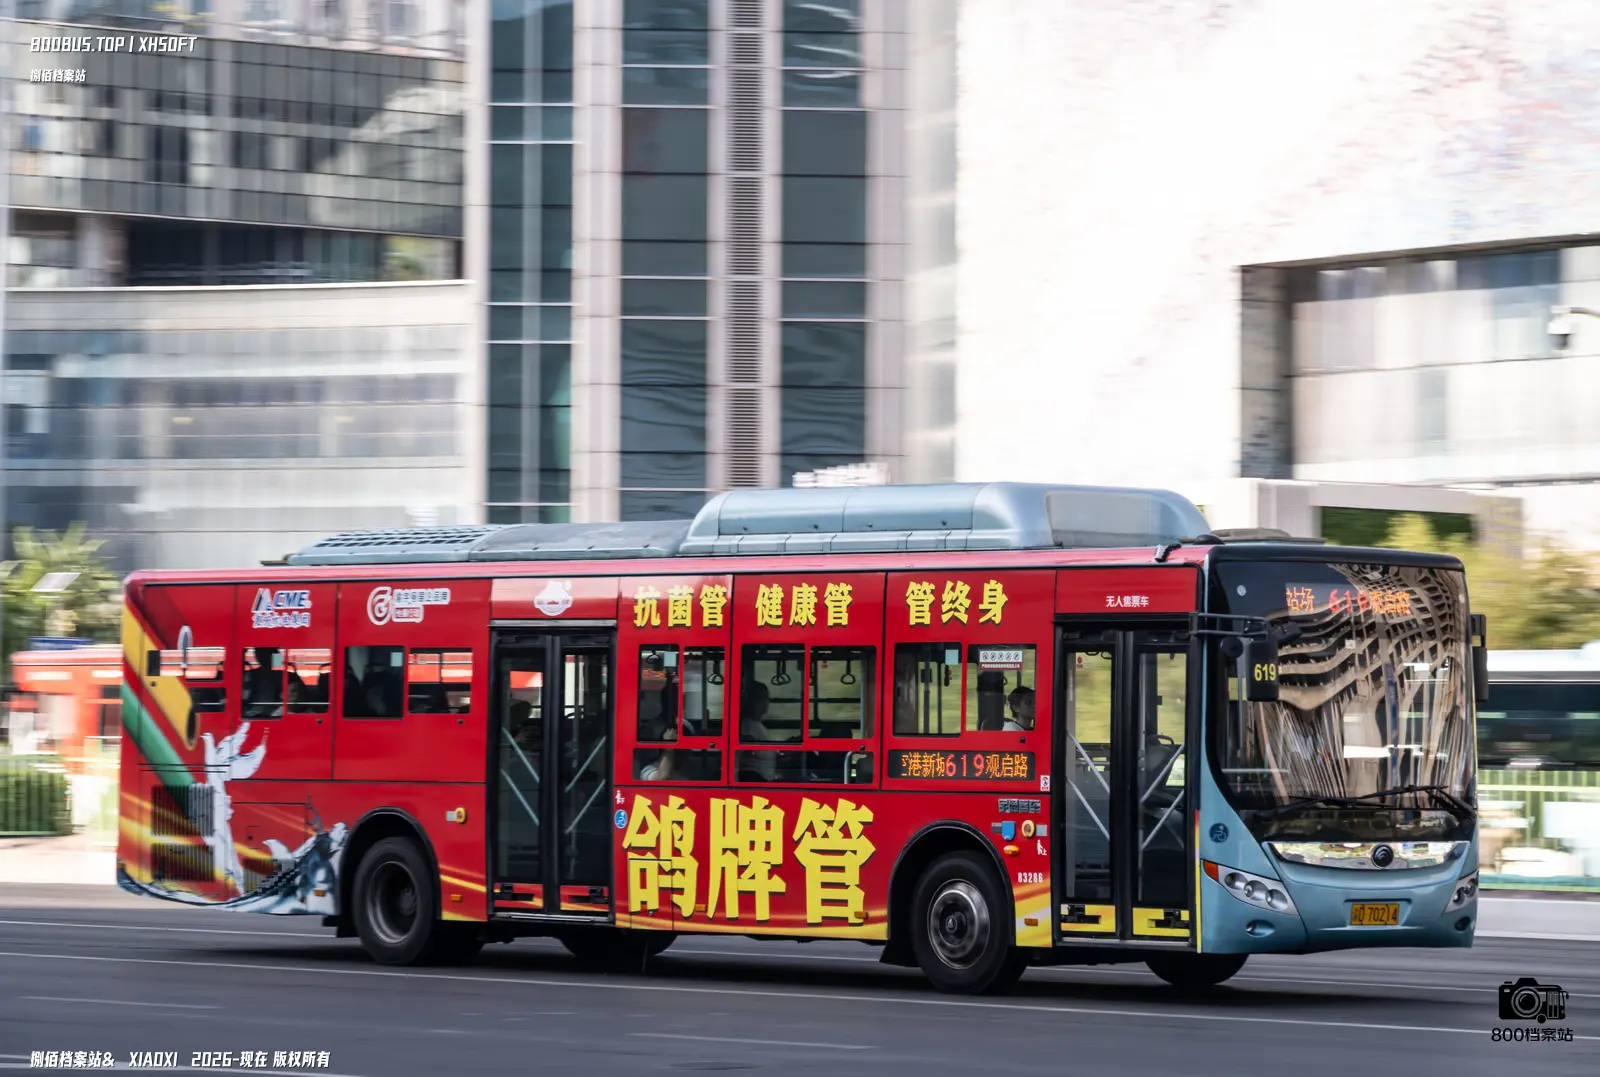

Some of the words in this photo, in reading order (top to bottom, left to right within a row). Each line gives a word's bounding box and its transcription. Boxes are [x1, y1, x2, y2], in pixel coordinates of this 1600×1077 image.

[633, 584, 728, 628] 抗菌管
[755, 582, 853, 627] 健康管
[905, 579, 1009, 626] 管终身
[1105, 595, 1149, 608] 无人售票车
[1328, 589, 1368, 613] 619
[1254, 663, 1276, 681] 619
[945, 753, 985, 777] 619
[985, 753, 1028, 779] 观启路
[622, 794, 877, 925] 鸽牌管
[1017, 872, 1043, 884] 83286
